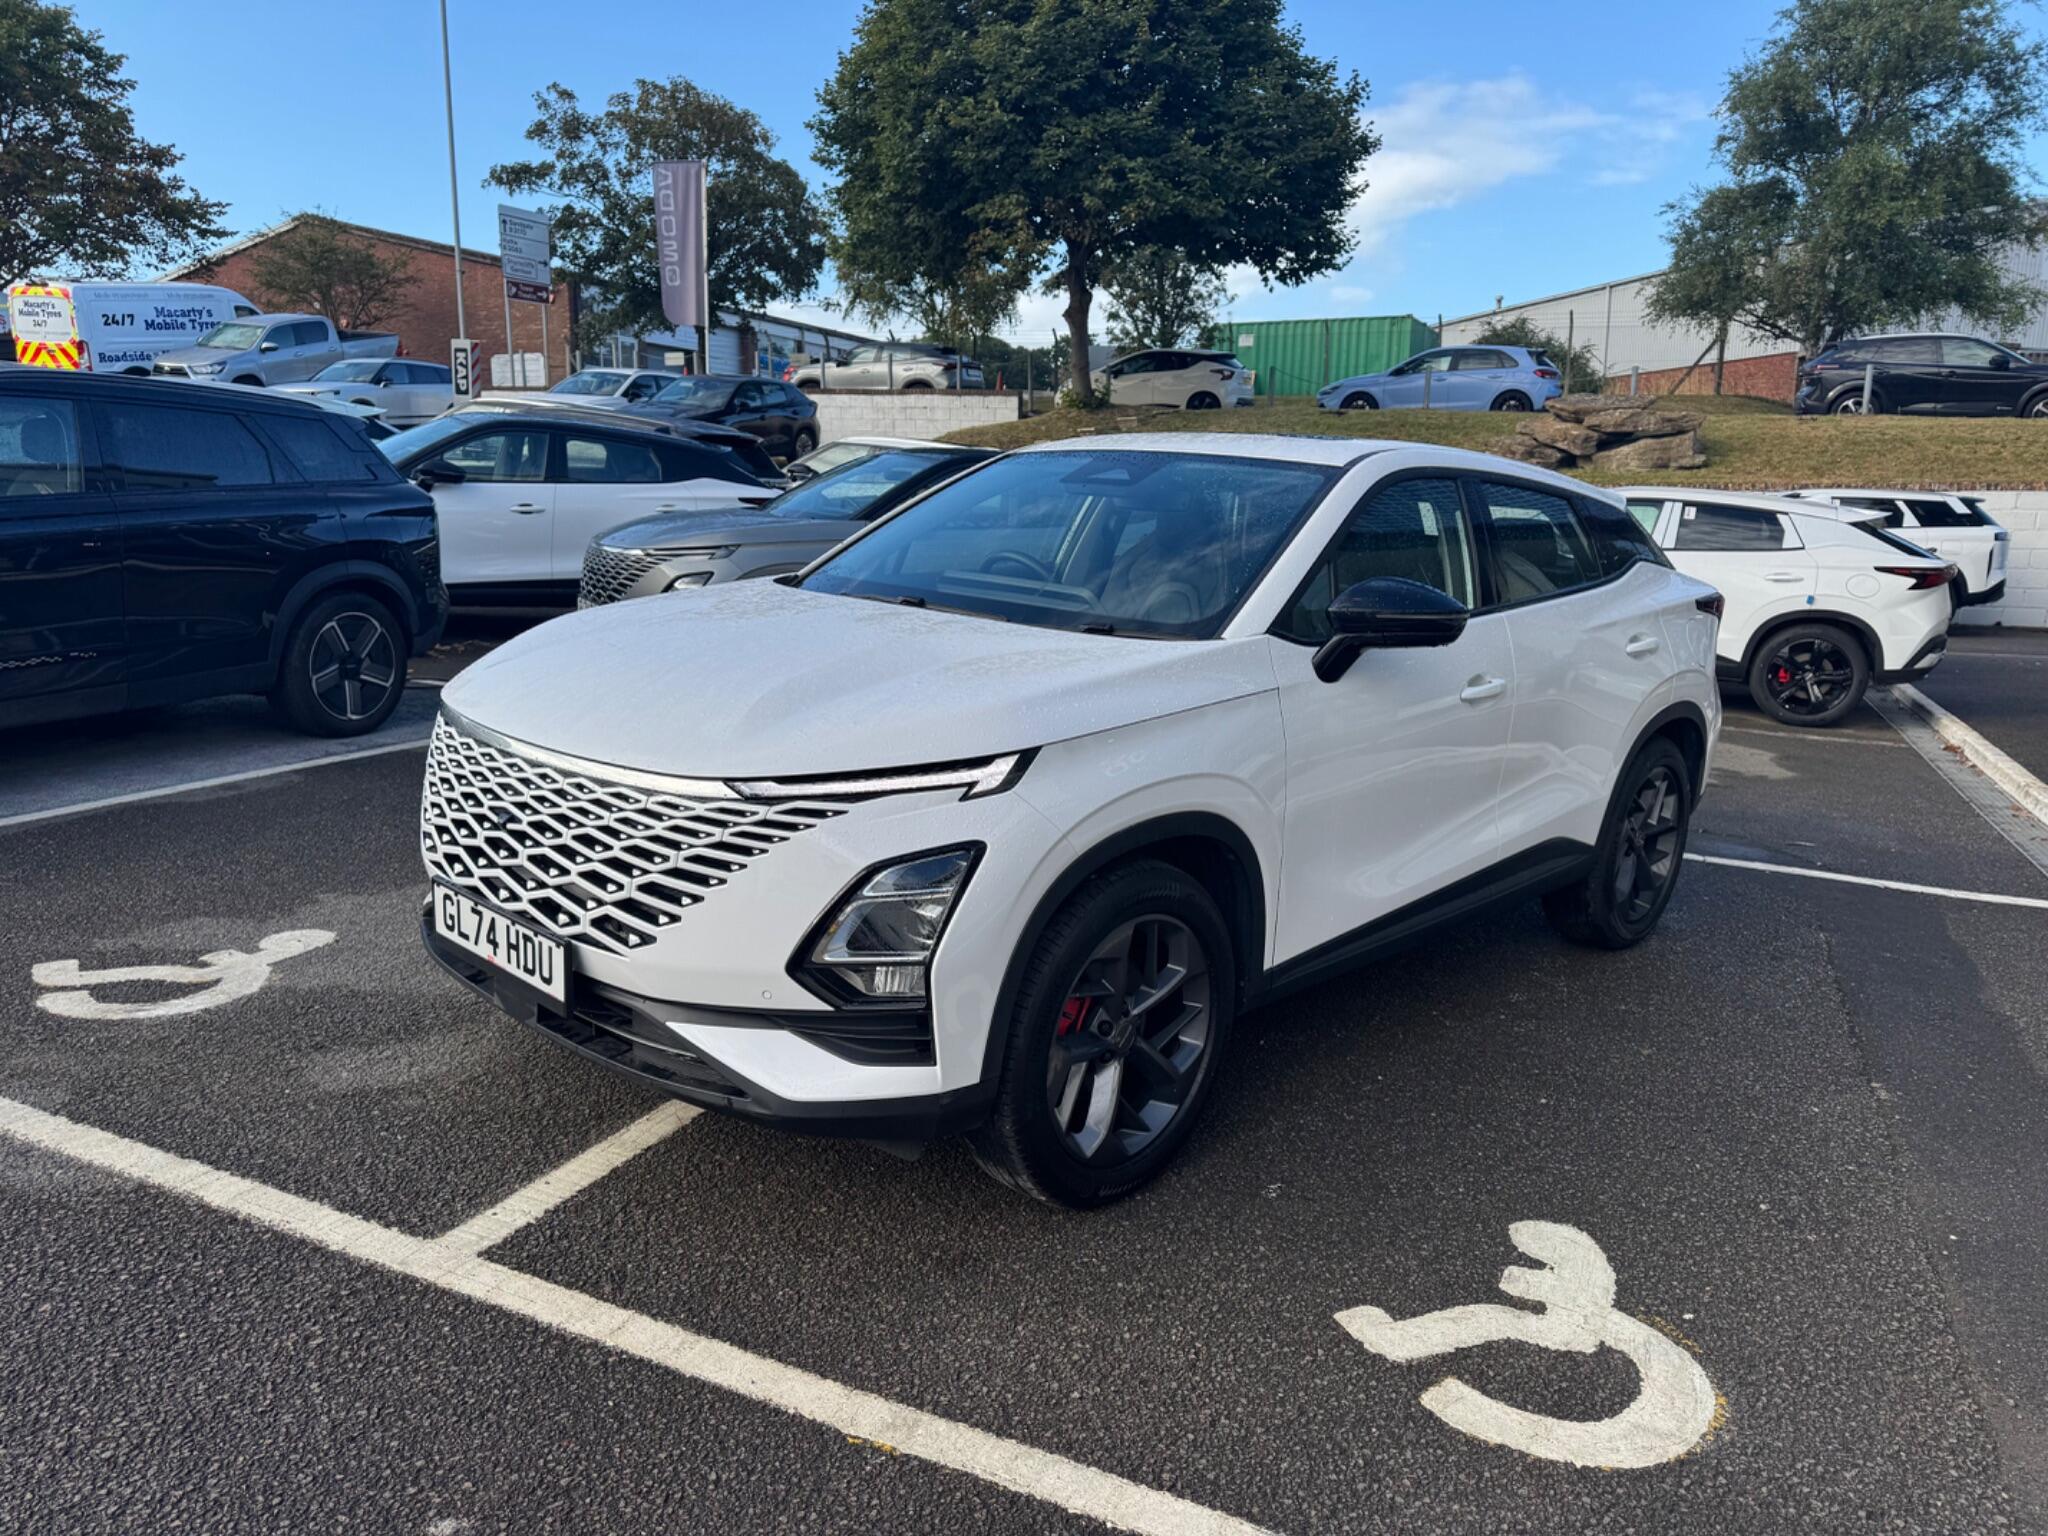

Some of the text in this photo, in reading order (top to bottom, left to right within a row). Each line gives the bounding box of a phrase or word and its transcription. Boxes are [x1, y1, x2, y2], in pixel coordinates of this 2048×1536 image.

[18, 308, 62, 319] Mobile Tyres
[154, 306, 213, 320] Macarty's
[144, 319, 187, 331] Mobile
[98, 351, 152, 364] Roadside
[456, 352, 468, 391] KAP
[443, 892, 553, 986] GL74 HDU
